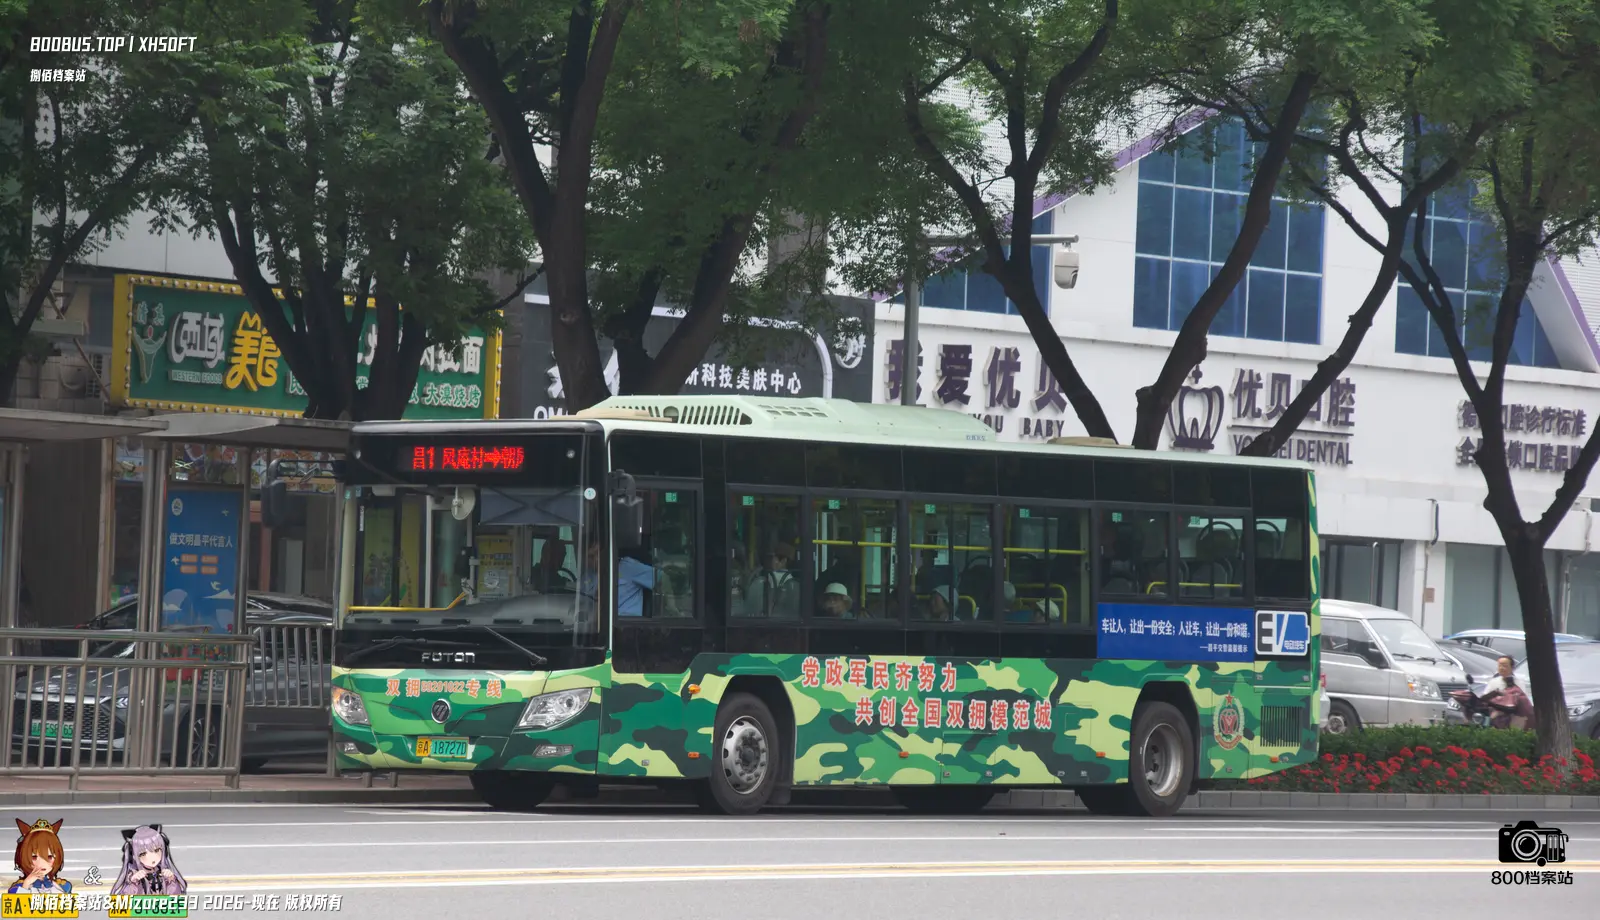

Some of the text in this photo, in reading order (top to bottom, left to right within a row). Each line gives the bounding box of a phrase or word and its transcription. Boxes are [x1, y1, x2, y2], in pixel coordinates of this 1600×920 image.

[1023, 417, 1065, 437] BABY
[1296, 438, 1354, 464] DENTAL
[169, 532, 233, 548] 做文明昌平代言人
[421, 651, 476, 663] FOTON
[802, 657, 957, 692] 党政军民齐努力
[855, 697, 1052, 729] 共创全国双拥模范城
